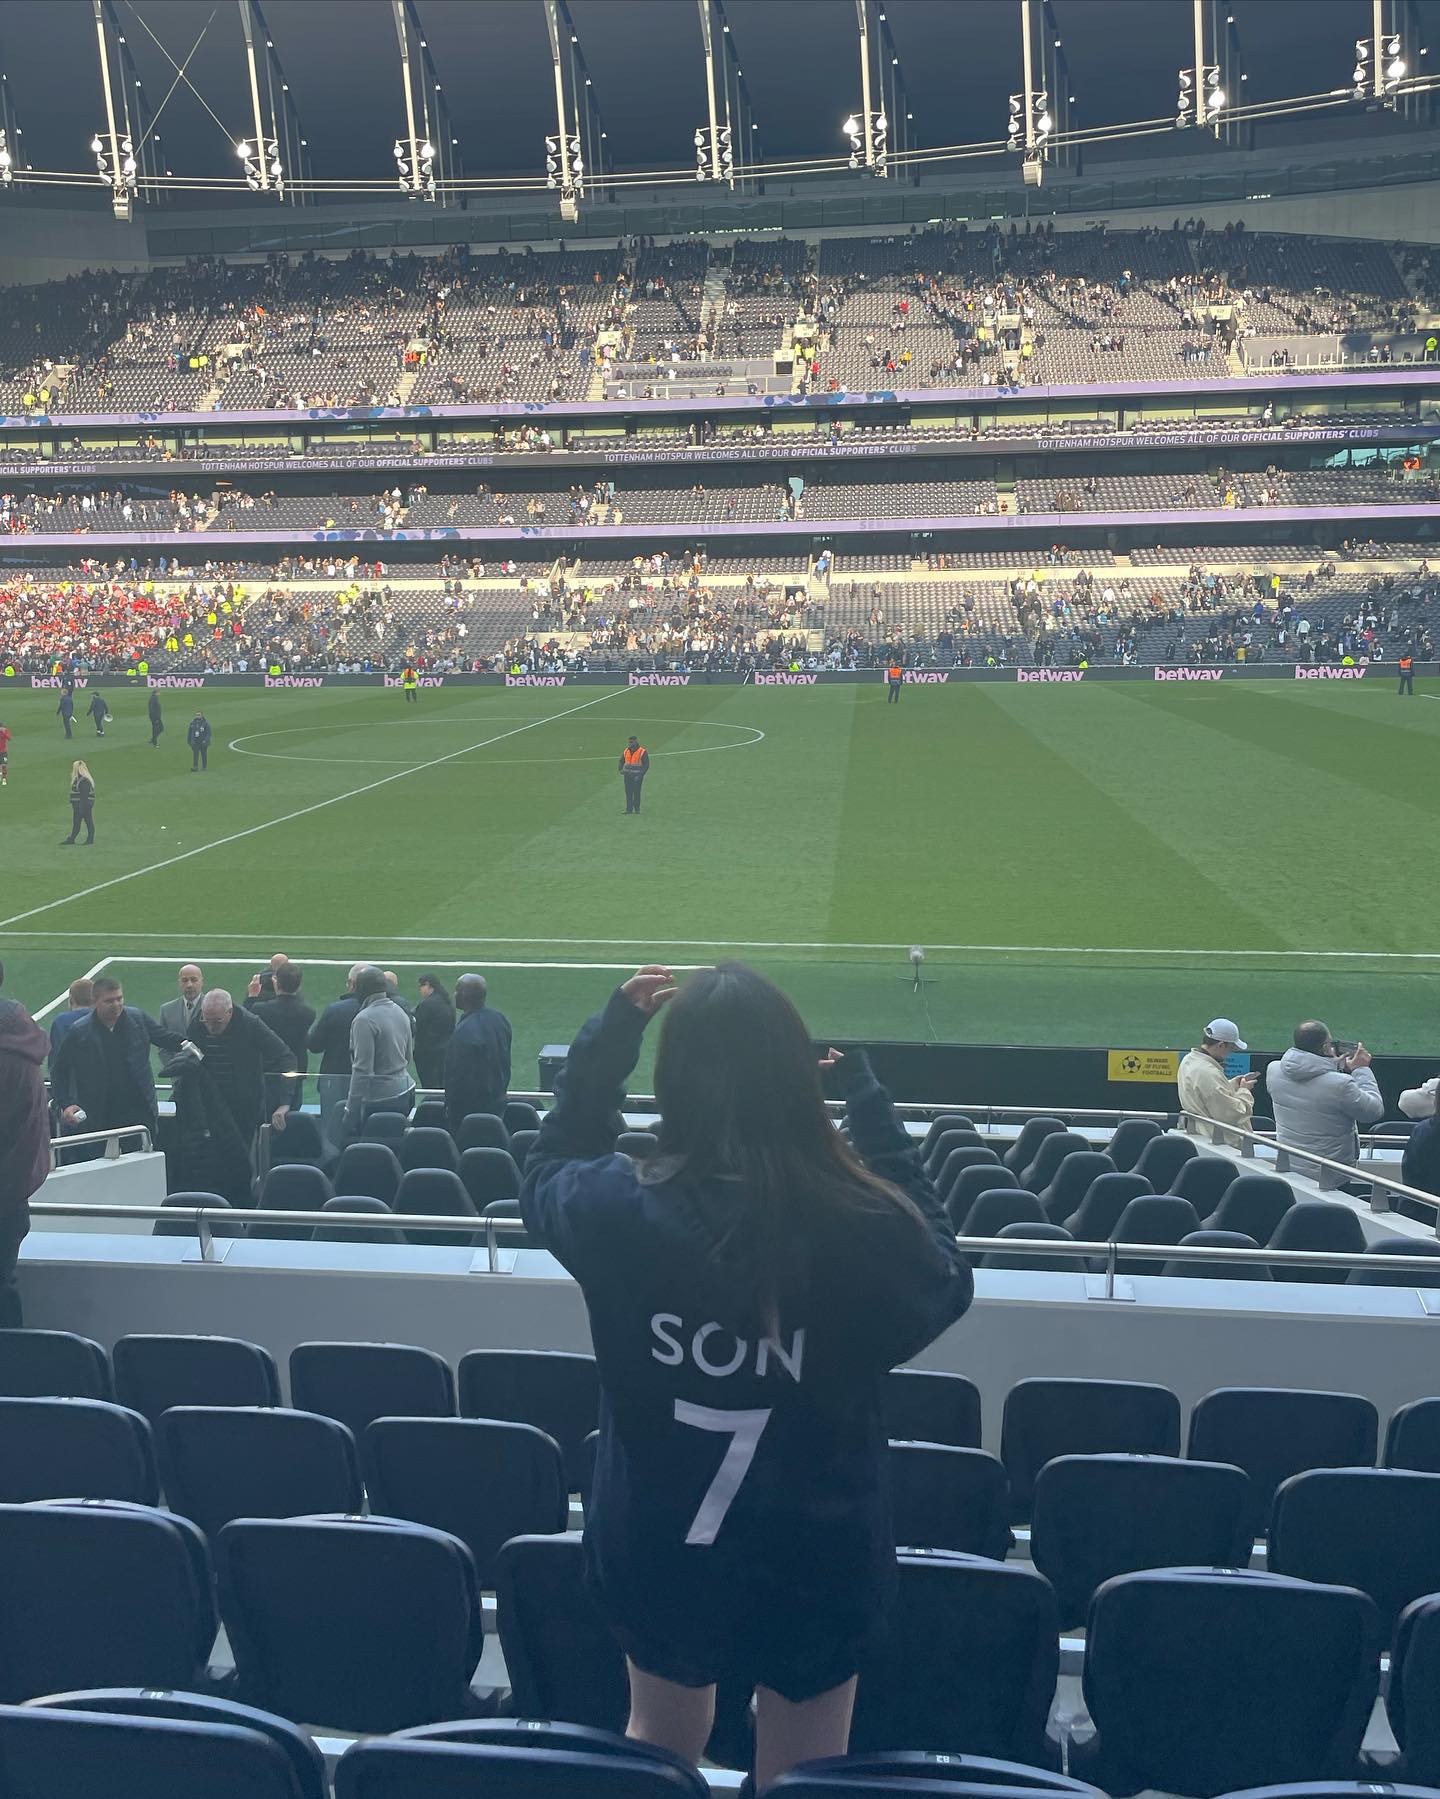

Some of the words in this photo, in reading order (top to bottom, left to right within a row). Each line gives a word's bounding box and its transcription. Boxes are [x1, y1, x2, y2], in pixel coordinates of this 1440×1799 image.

[1038, 440, 1091, 448] TOTTENHAM
[1093, 438, 1133, 446] HOTSPUR
[1136, 436, 1185, 445] WELCOMES
[1188, 436, 1204, 444] ALL
[1207, 434, 1219, 443] OF
[1221, 434, 1239, 442] OUR
[1242, 433, 1282, 441] OFFICIAL
[1350, 430, 1378, 438] CLUBS
[377, 458, 411, 466] OFFICIAL
[605, 454, 653, 462] TOTTENHAM
[654, 452, 692, 460] HOTSPUR
[694, 451, 739, 459] WELCOMES
[772, 449, 789, 457] OUR
[791, 448, 828, 456] OFFICIAL
[890, 445, 916, 453] CLUBS
[651, 1313, 804, 1382] SON
[674, 1399, 772, 1544] 7
